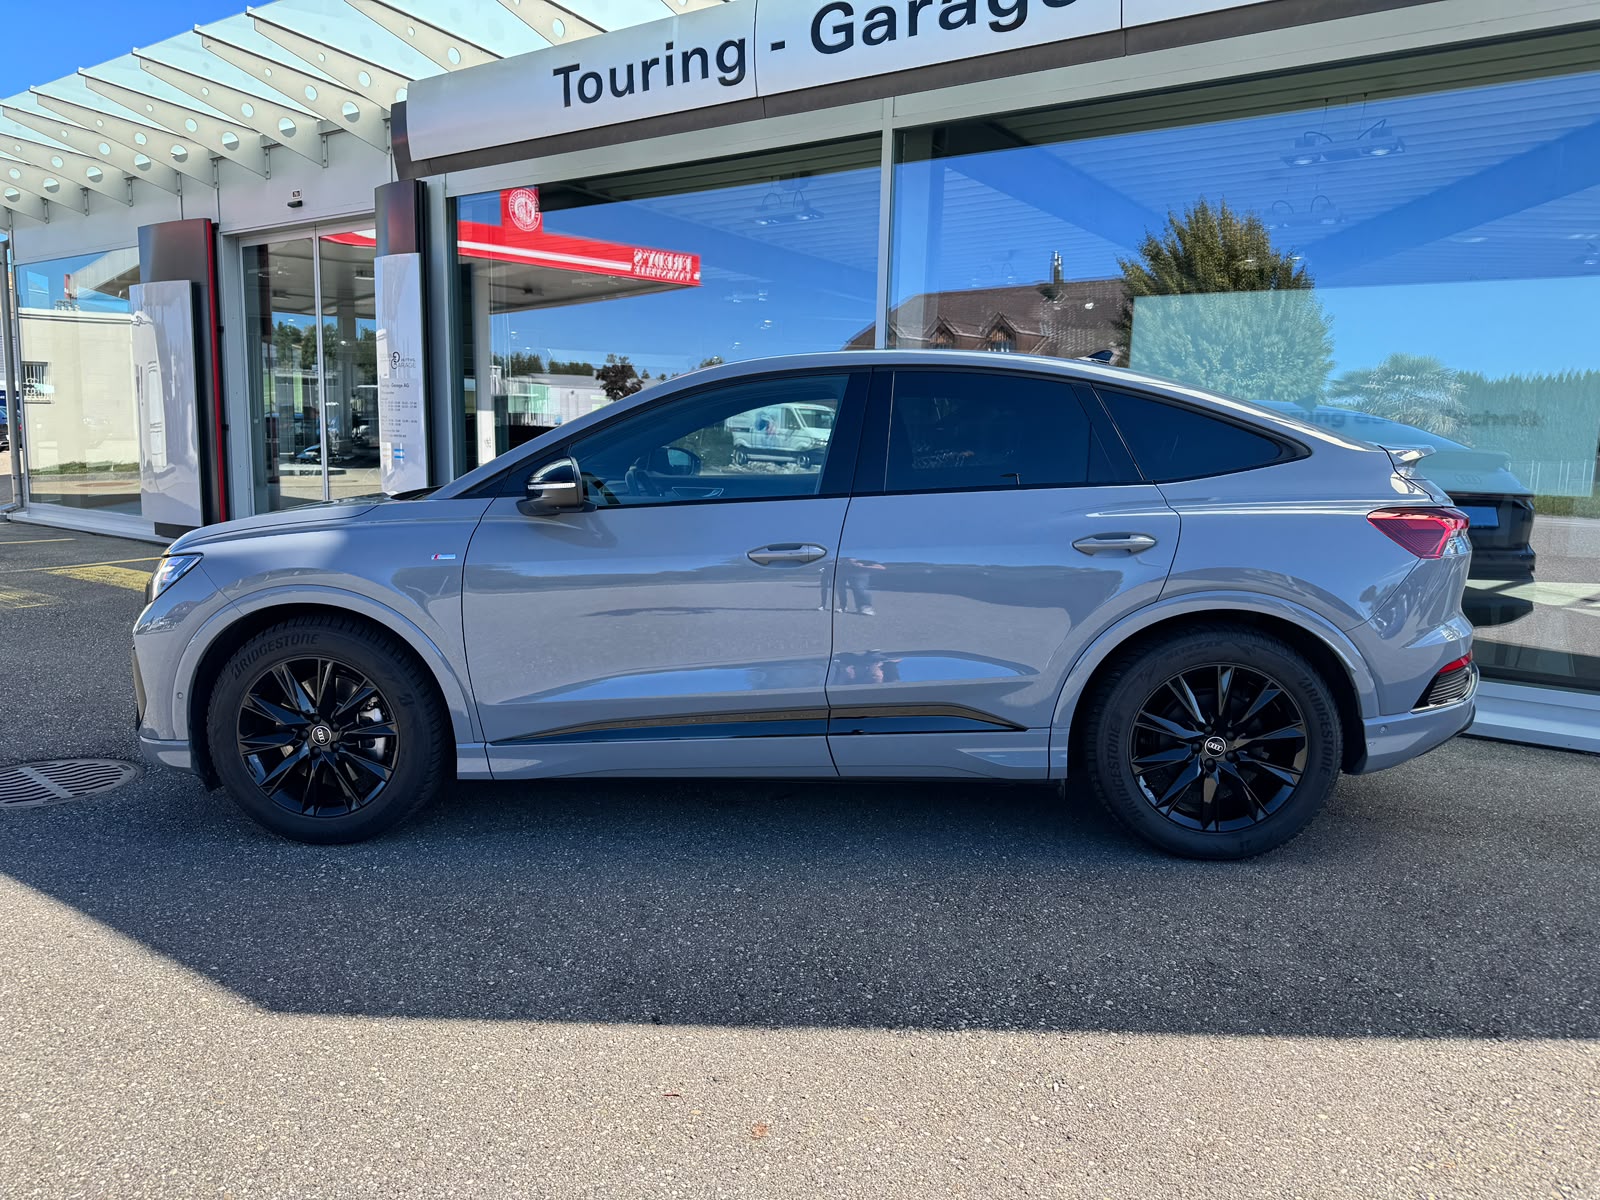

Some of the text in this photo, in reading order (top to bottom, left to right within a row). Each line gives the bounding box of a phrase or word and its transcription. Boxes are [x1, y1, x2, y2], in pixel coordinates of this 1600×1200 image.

[553, 37, 748, 107] Touring
[811, 0, 1074, 54] Garag
[231, 633, 320, 681] BRIDGESTONE
[1299, 675, 1334, 777] BRIDGESTONE
